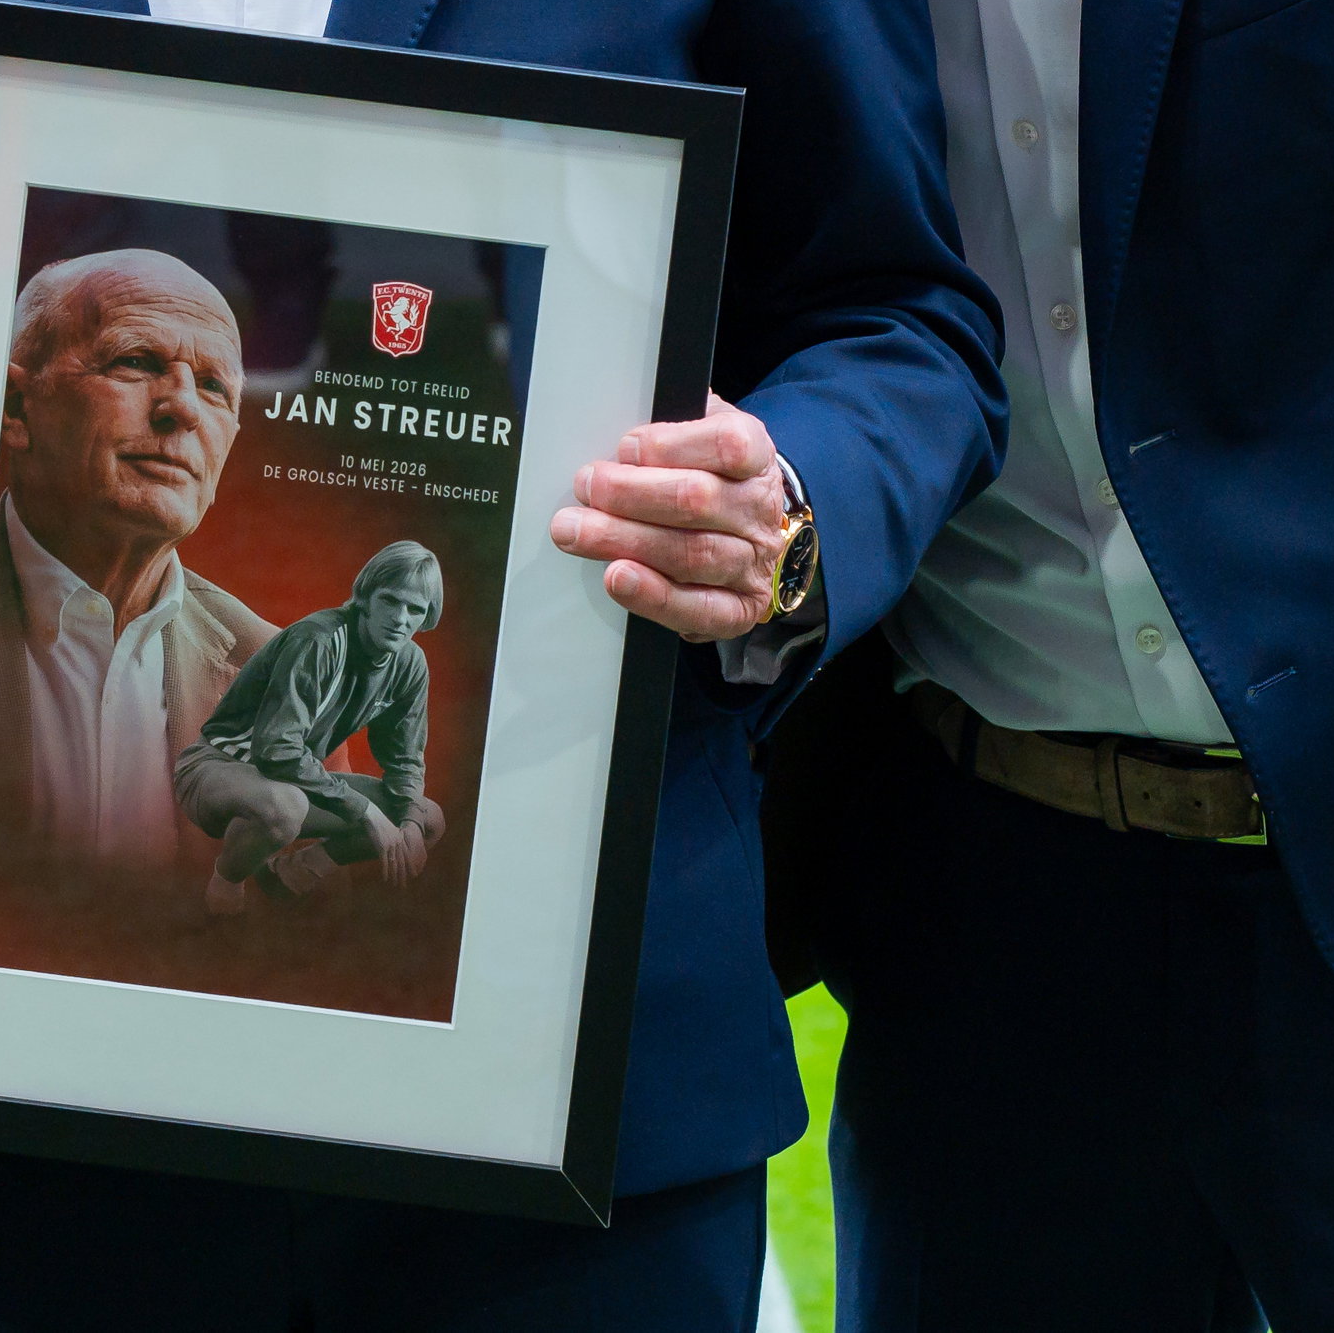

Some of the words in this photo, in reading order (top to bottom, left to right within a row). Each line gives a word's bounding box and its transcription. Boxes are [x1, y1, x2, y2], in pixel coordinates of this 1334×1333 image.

[392, 286, 428, 300] TWENTE
[315, 370, 384, 390] BENOEMD
[391, 378, 418, 394] TOT
[423, 382, 470, 400] ERELID
[265, 391, 337, 426] JAN
[353, 401, 512, 446] STREUER
[340, 454, 355, 469] 10
[360, 457, 385, 472] MEI
[390, 460, 427, 477] 2026
[263, 464, 282, 479] DE
[287, 467, 357, 487] GROLSCH
[363, 476, 405, 493] VESTE
[424, 482, 500, 504] ENSCHEDE
